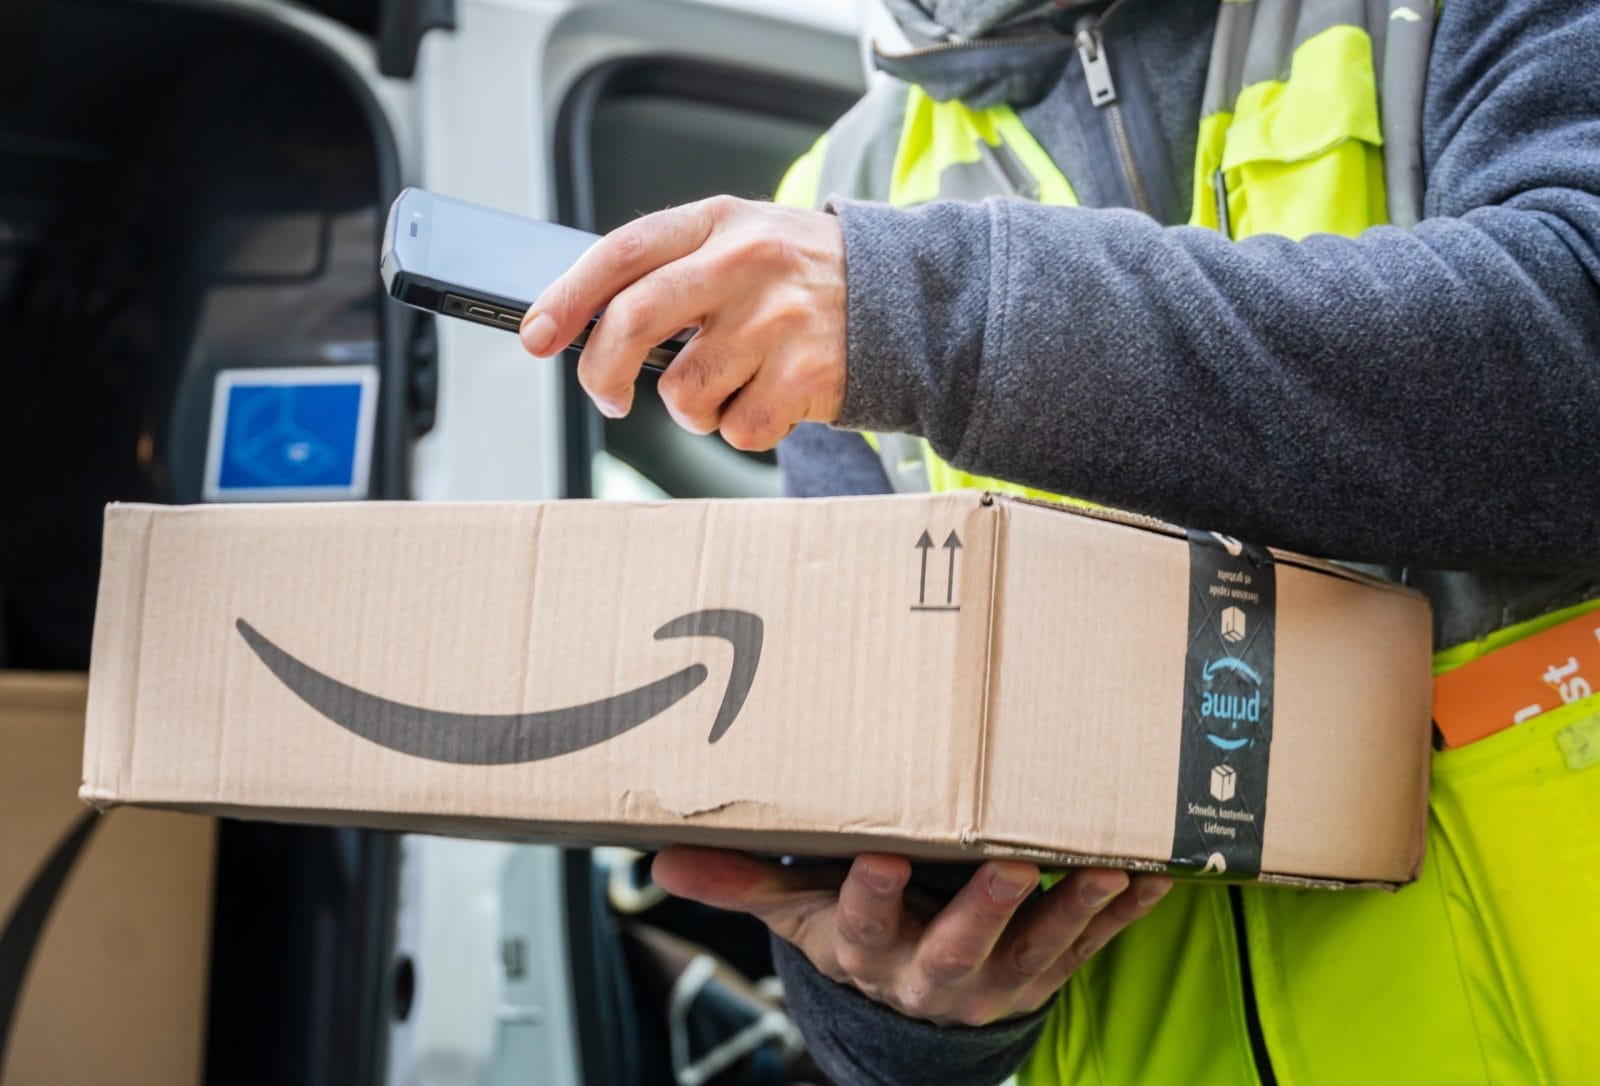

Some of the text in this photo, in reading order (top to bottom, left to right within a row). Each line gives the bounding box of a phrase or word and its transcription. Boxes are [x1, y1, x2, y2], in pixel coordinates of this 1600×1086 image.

[1217, 570, 1252, 585] et gratuite
[1201, 689, 1261, 730] prime
[1187, 802, 1254, 822] Schnelle, kostenlose
[1203, 821, 1236, 839] Lieferung
